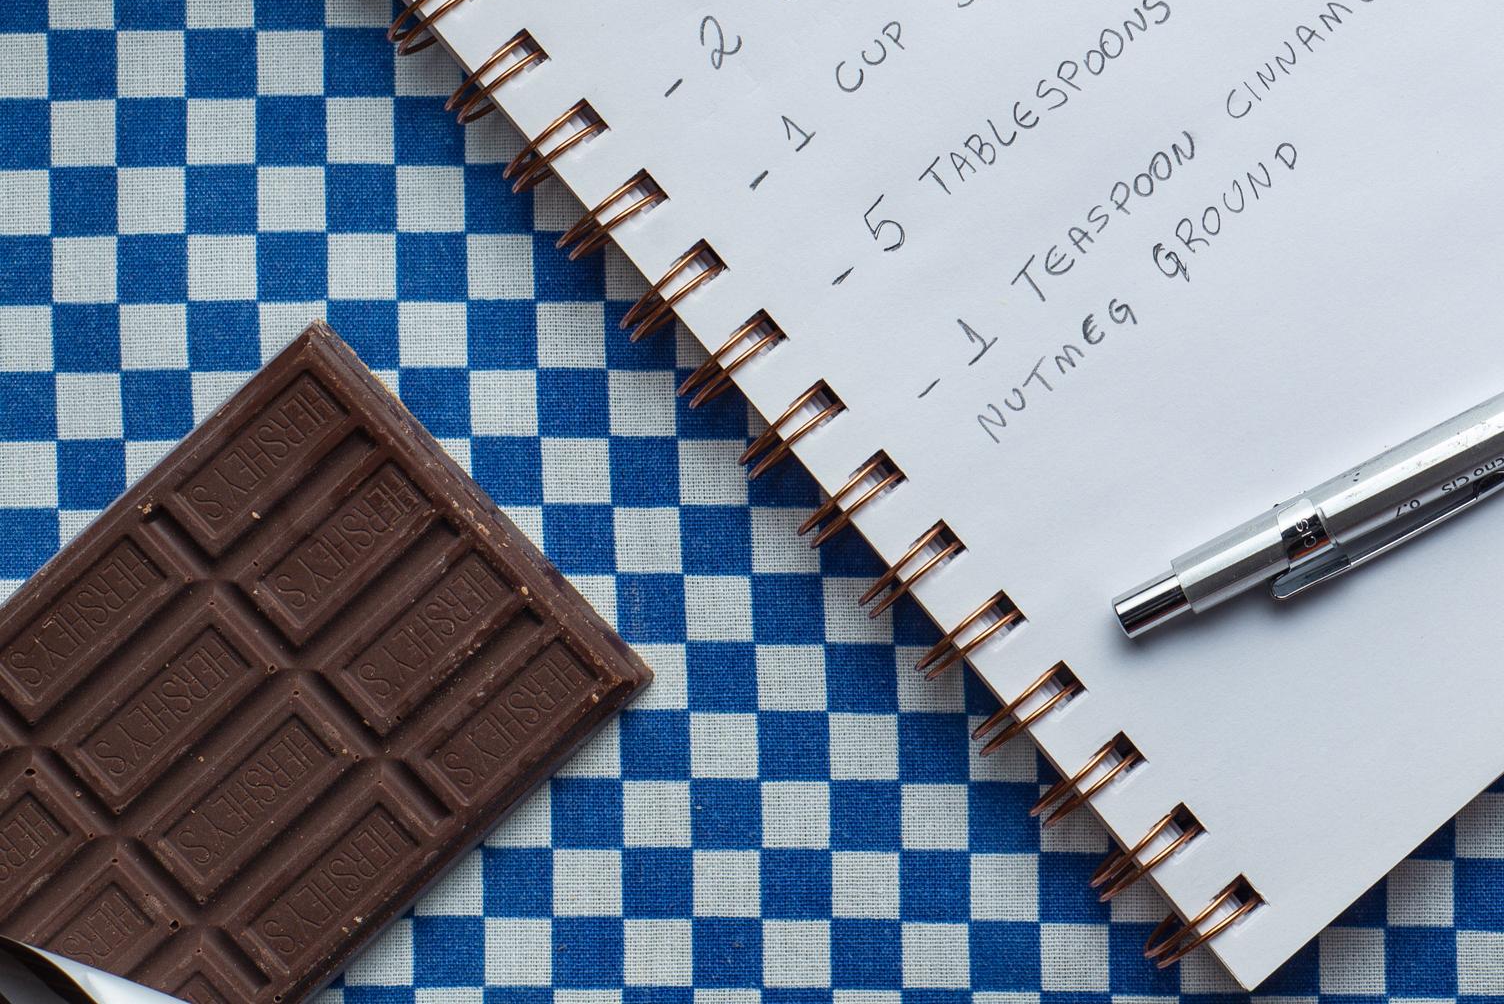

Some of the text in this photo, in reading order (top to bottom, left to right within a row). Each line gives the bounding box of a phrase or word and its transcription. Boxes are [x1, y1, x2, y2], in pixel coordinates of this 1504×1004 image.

[700, 11, 744, 72] 2
[781, 115, 816, 152] 1
[835, 21, 905, 93] CUP
[864, 194, 905, 252] 5
[957, 318, 998, 366] 1
[1011, 130, 1195, 302] TEASPOON
[977, 142, 1297, 444] NUTMEG GROUND
[192, 379, 336, 519] HERSHEY'S
[1395, 499, 1421, 518] 0.7
[276, 470, 421, 608] HERSHEY'S
[10, 548, 157, 687] HERSHEY'S
[358, 560, 504, 697] HERSHEY'S
[95, 638, 240, 776] HERSHEY'S
[442, 646, 590, 787] HERSHEY'S
[178, 726, 326, 865] HERSHEY'S
[264, 814, 411, 954] HERSHEY'S
